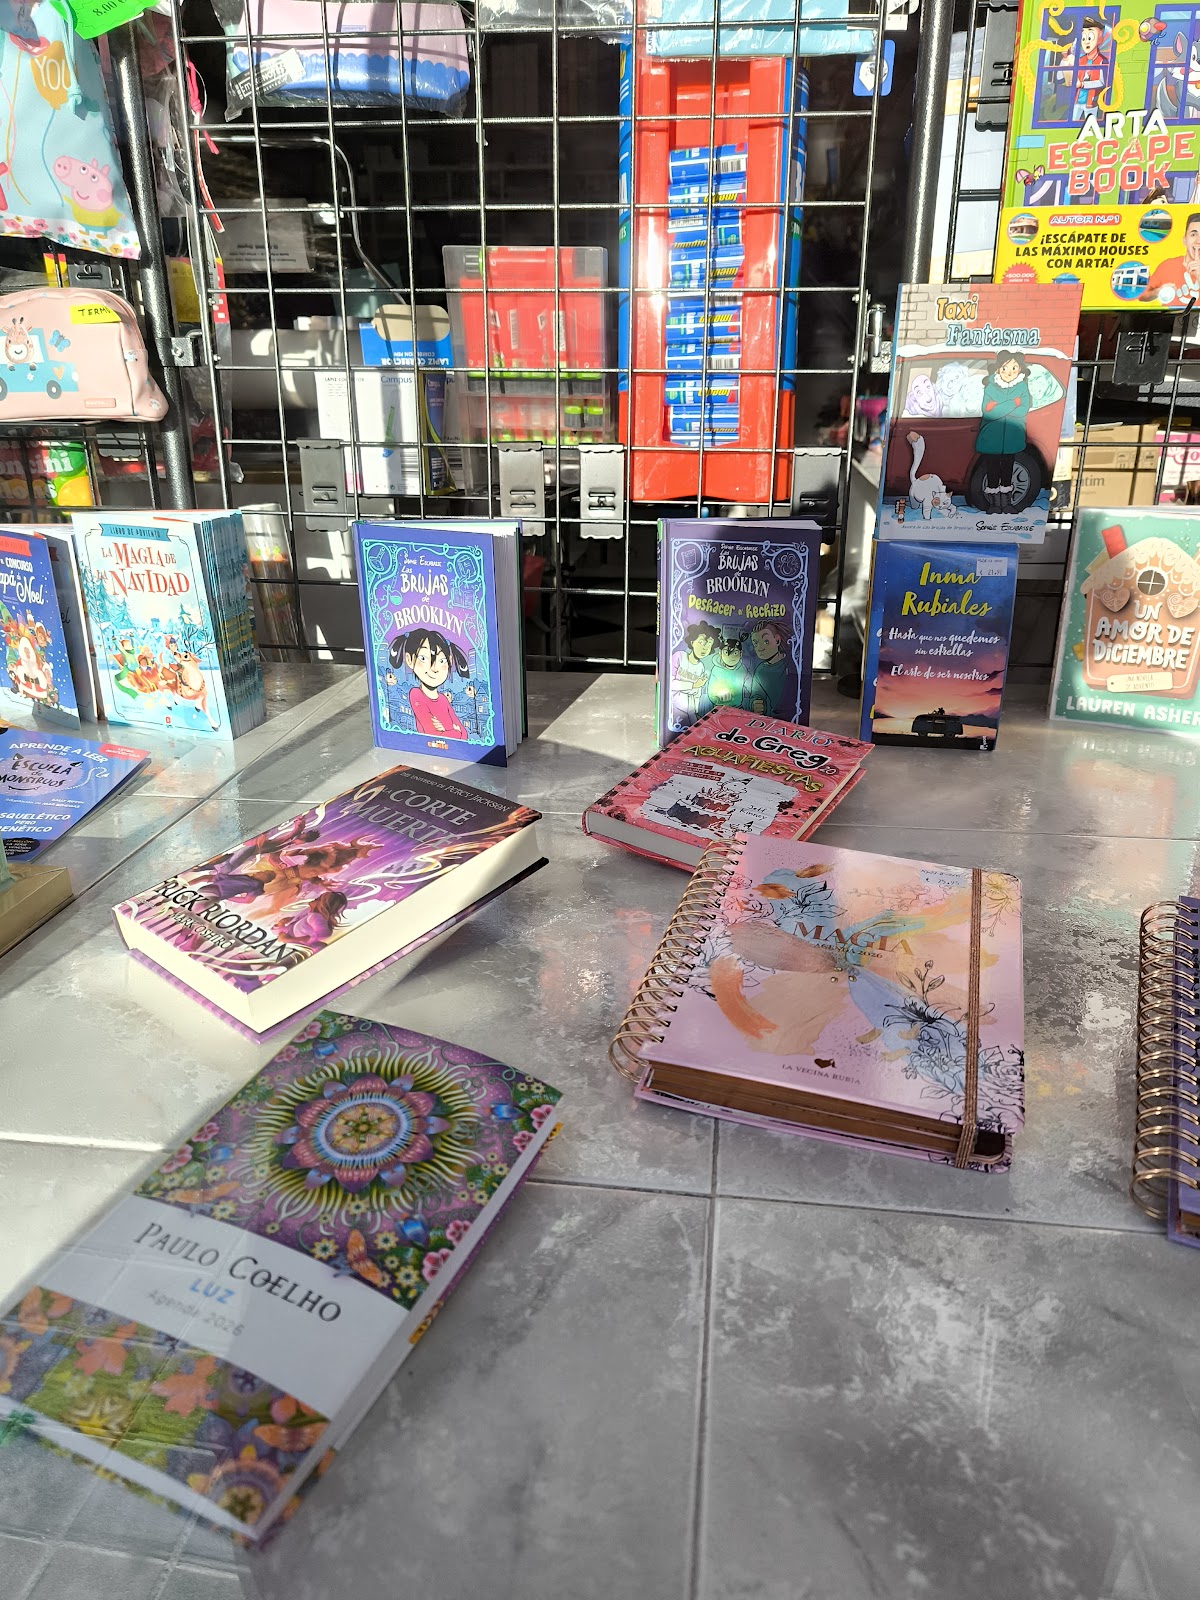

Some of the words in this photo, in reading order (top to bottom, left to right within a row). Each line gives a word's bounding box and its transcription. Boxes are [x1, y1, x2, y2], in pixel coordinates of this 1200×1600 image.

[1076, 108, 1169, 140] ARTA
[1047, 131, 1196, 171] ESCAPE
[1068, 161, 1172, 196] BOOK
[1050, 215, 1093, 225] AUTOR
[1015, 246, 1038, 257] LAS
[1041, 244, 1096, 257] MÁXIMO
[1099, 245, 1149, 256] HOUSES
[1040, 231, 1108, 245] ¡ESCÁPATE
[1110, 233, 1127, 243] DE
[1046, 258, 1073, 269] CON
[1075, 257, 1115, 269] ARTA!
[935, 294, 979, 323] Taxi
[946, 323, 1040, 346] Fantasma
[380, 375, 413, 385] Campus
[101, 547, 113, 558] LA
[112, 541, 166, 569] MAGIA
[164, 553, 177, 564] DE
[109, 567, 190, 598] NAVIDAD
[706, 575, 771, 599] BROOKLYN
[919, 561, 983, 586] Inma
[421, 594, 431, 603] de
[901, 588, 993, 617] Rubiales
[1133, 599, 1163, 621] UN
[393, 604, 464, 638] BROOKLYN
[1094, 616, 1163, 645] AMOR
[1167, 624, 1196, 646] DE
[888, 627, 919, 640] Hasta
[918, 634, 934, 645] que
[948, 629, 1000, 647] quedemos
[914, 647, 928, 656] sin
[928, 643, 974, 658] estrellas
[890, 663, 904, 677] El
[903, 665, 924, 678] arte
[923, 665, 937, 679] de
[936, 669, 952, 679] ser
[952, 668, 990, 681] nosotros
[1066, 695, 1136, 717] LAUREN
[1143, 704, 1200, 727] ASHER
[744, 718, 834, 747] DIARIO
[9, 742, 73, 752] APRENDE
[82, 750, 109, 763] LEER
[713, 727, 750, 745] de
[752, 735, 832, 771] Greg
[11, 759, 73, 775] ESCUELA
[680, 744, 825, 793] AGUAFIESTAS
[0, 774, 66, 788] MONSTRUOS
[389, 789, 477, 826] CORTE
[445, 785, 473, 798] PERCY
[470, 794, 511, 812] JACKSON
[0, 812, 71, 821] SQUELÉTICO
[0, 824, 53, 833] ENÉTICO
[351, 803, 462, 850] MUERTE
[154, 880, 210, 912] RICK
[196, 902, 301, 964] RIORDAN
[169, 910, 199, 929] MARK
[194, 923, 236, 950] OSHIRO
[793, 920, 914, 956] MAGIA
[781, 1063, 793, 1071] LA
[795, 1065, 830, 1079] VECINA
[133, 1221, 220, 1267] PAULO
[228, 1255, 342, 1323] COELHO
[188, 1277, 236, 1305] LUZ
